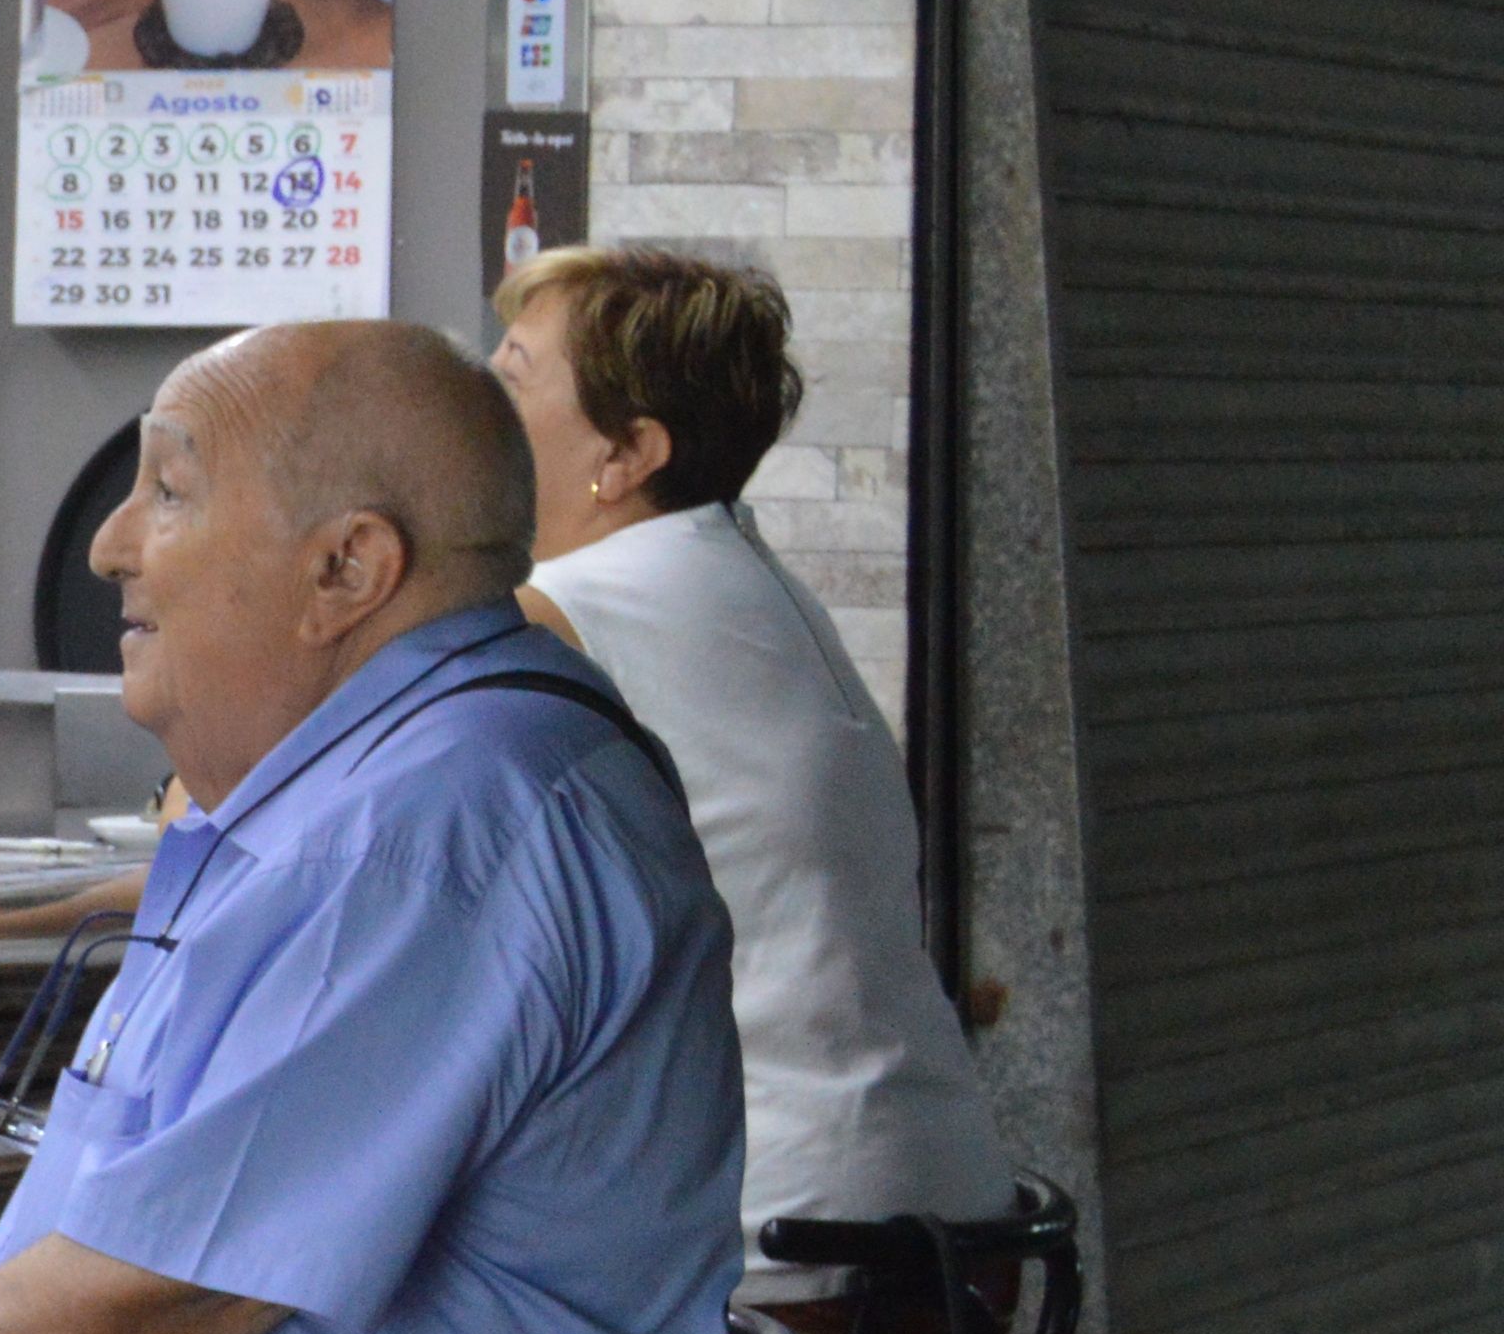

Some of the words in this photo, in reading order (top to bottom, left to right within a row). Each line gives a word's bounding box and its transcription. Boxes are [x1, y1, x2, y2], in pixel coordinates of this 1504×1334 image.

[148, 91, 260, 116] Agosto
[66, 136, 75, 156] 1
[110, 136, 124, 156] 2
[155, 136, 169, 155] 3
[200, 137, 216, 154] 4
[249, 135, 263, 155] 5
[294, 135, 311, 154] 6
[341, 134, 357, 153] 7
[62, 174, 78, 193] 8
[108, 173, 124, 193] 9
[146, 173, 177, 193] 10
[196, 173, 218, 192] 11
[241, 173, 268, 193] 12
[333, 171, 361, 190] 14
[56, 210, 83, 231] 15
[101, 210, 130, 230] 16
[147, 210, 174, 230] 17
[193, 210, 221, 230] 18
[240, 210, 268, 229] 19
[283, 209, 318, 230] 20
[332, 208, 358, 229] 21
[52, 247, 85, 268] 22
[100, 248, 130, 267] 23
[144, 248, 176, 268] 24
[190, 247, 222, 267] 25
[237, 248, 270, 267] 26
[283, 246, 315, 267] 27
[327, 246, 360, 266] 28
[51, 285, 84, 304] 29
[96, 285, 130, 304] 30
[145, 285, 170, 305] 31
